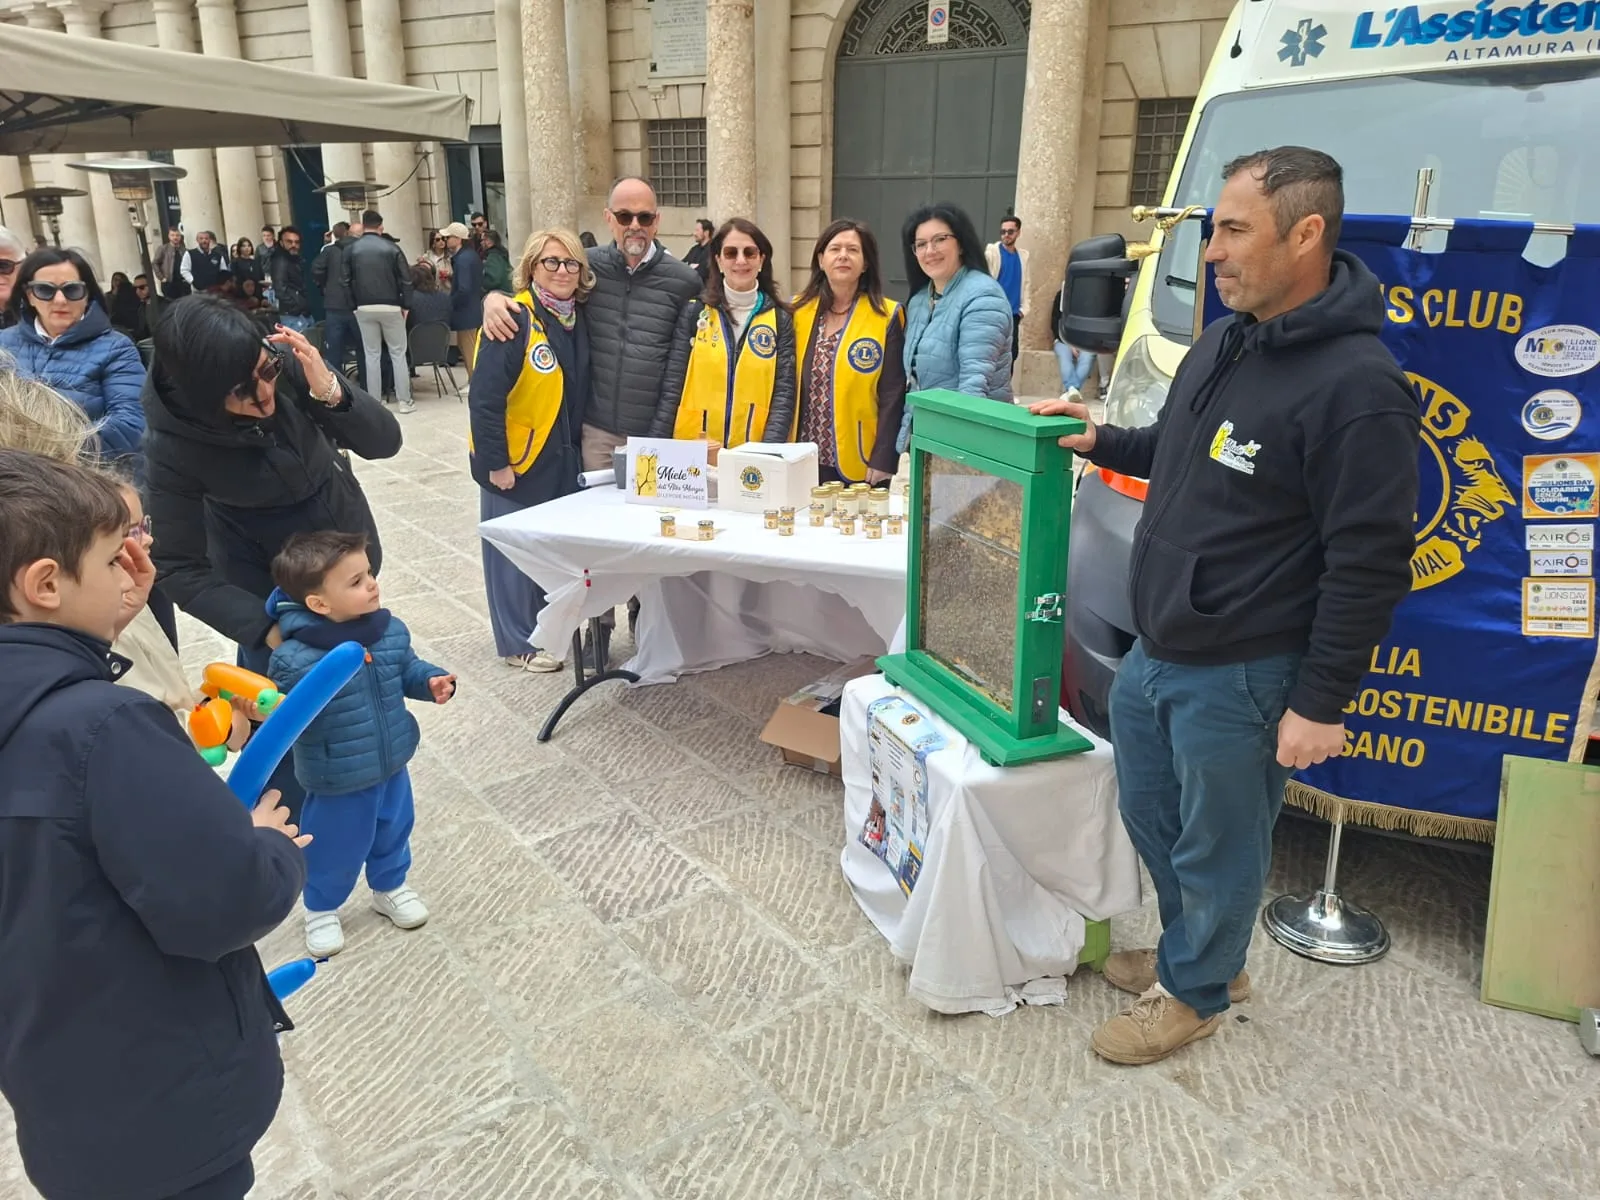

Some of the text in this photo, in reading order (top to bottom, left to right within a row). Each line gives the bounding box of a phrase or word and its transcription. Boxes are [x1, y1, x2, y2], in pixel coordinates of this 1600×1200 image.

[1446, 40, 1575, 61] ALTAMURA
[1422, 287, 1523, 334] CLUB
[657, 466, 688, 480] Miele
[1544, 591, 1586, 600] LIONS DAY
